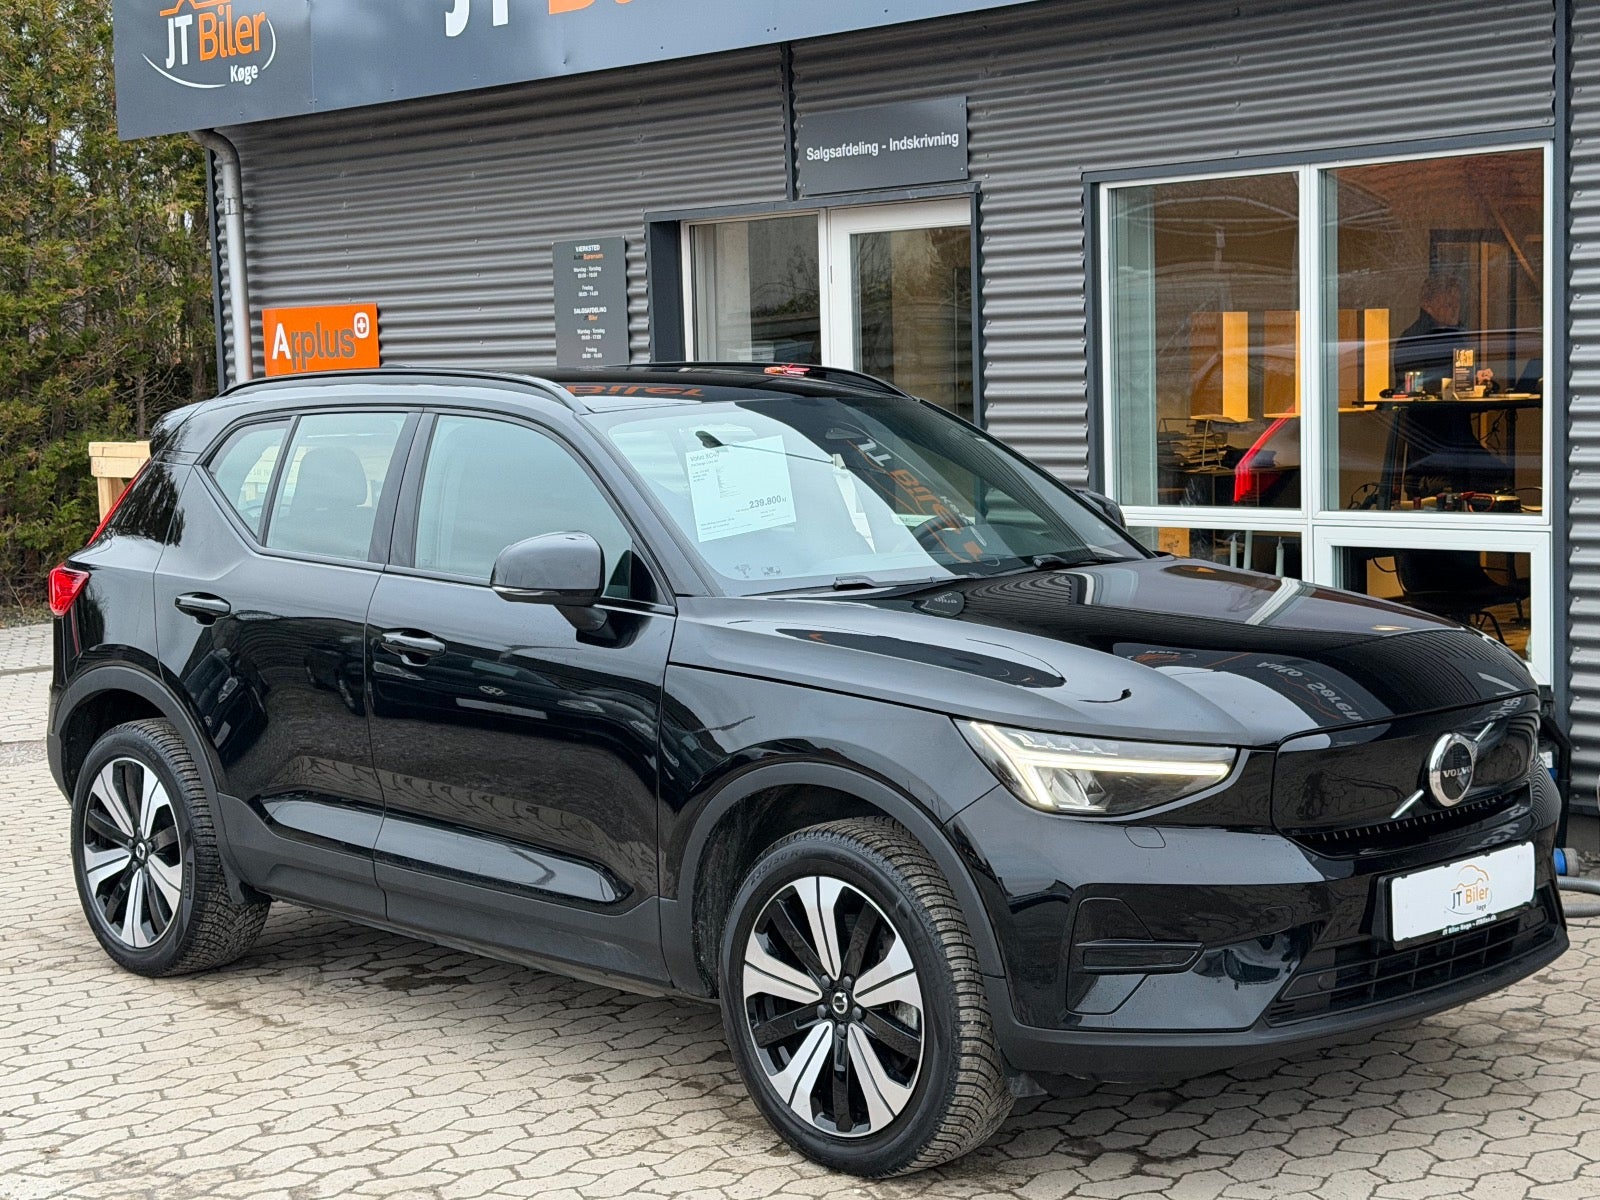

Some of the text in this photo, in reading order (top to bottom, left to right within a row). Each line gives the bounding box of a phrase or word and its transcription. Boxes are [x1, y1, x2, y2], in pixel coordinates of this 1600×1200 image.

[165, 4, 266, 69] JT Biler
[230, 64, 259, 86] Køge
[806, 141, 879, 162] Salgsafdeling
[889, 131, 959, 151] Indskrivning
[748, 495, 782, 510] 239.800
[1442, 765, 1472, 778] VOLVO
[1452, 886, 1490, 910] JT Biler
